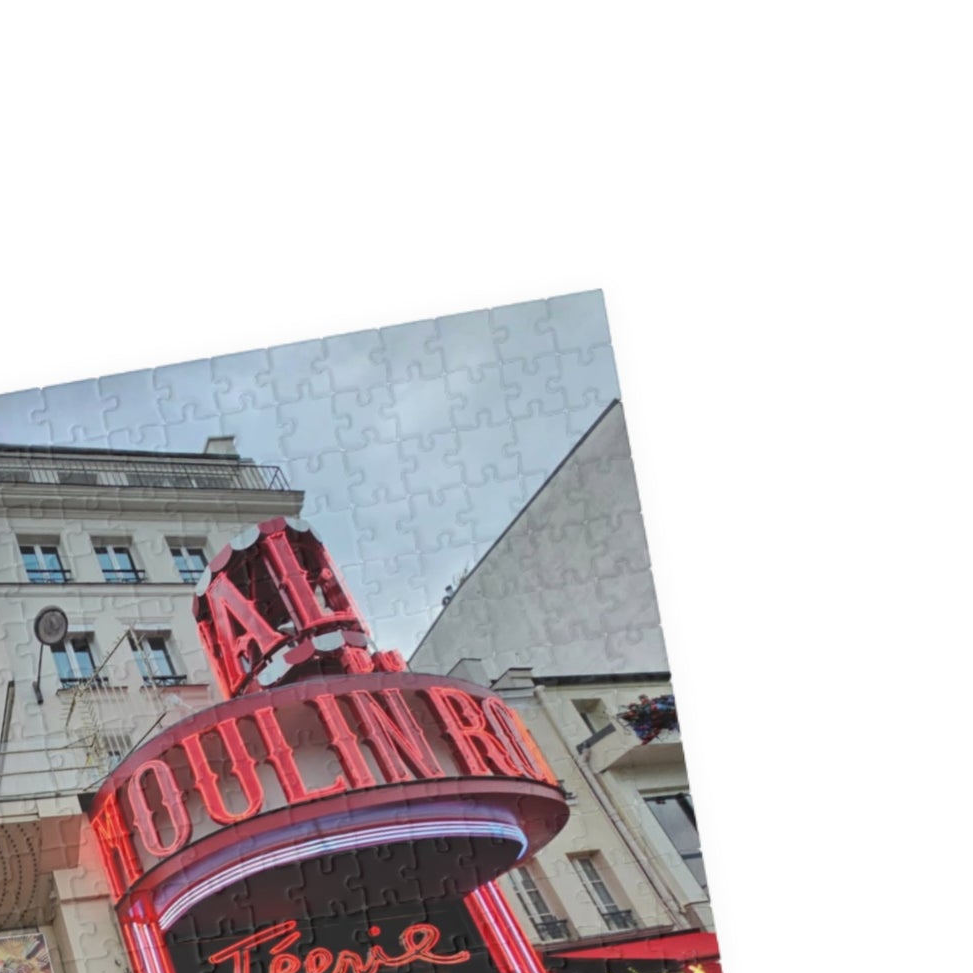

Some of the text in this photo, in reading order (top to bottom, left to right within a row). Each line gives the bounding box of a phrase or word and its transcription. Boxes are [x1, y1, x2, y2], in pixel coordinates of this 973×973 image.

[197, 530, 360, 700] AL
[90, 685, 560, 905] MOULIN RO
